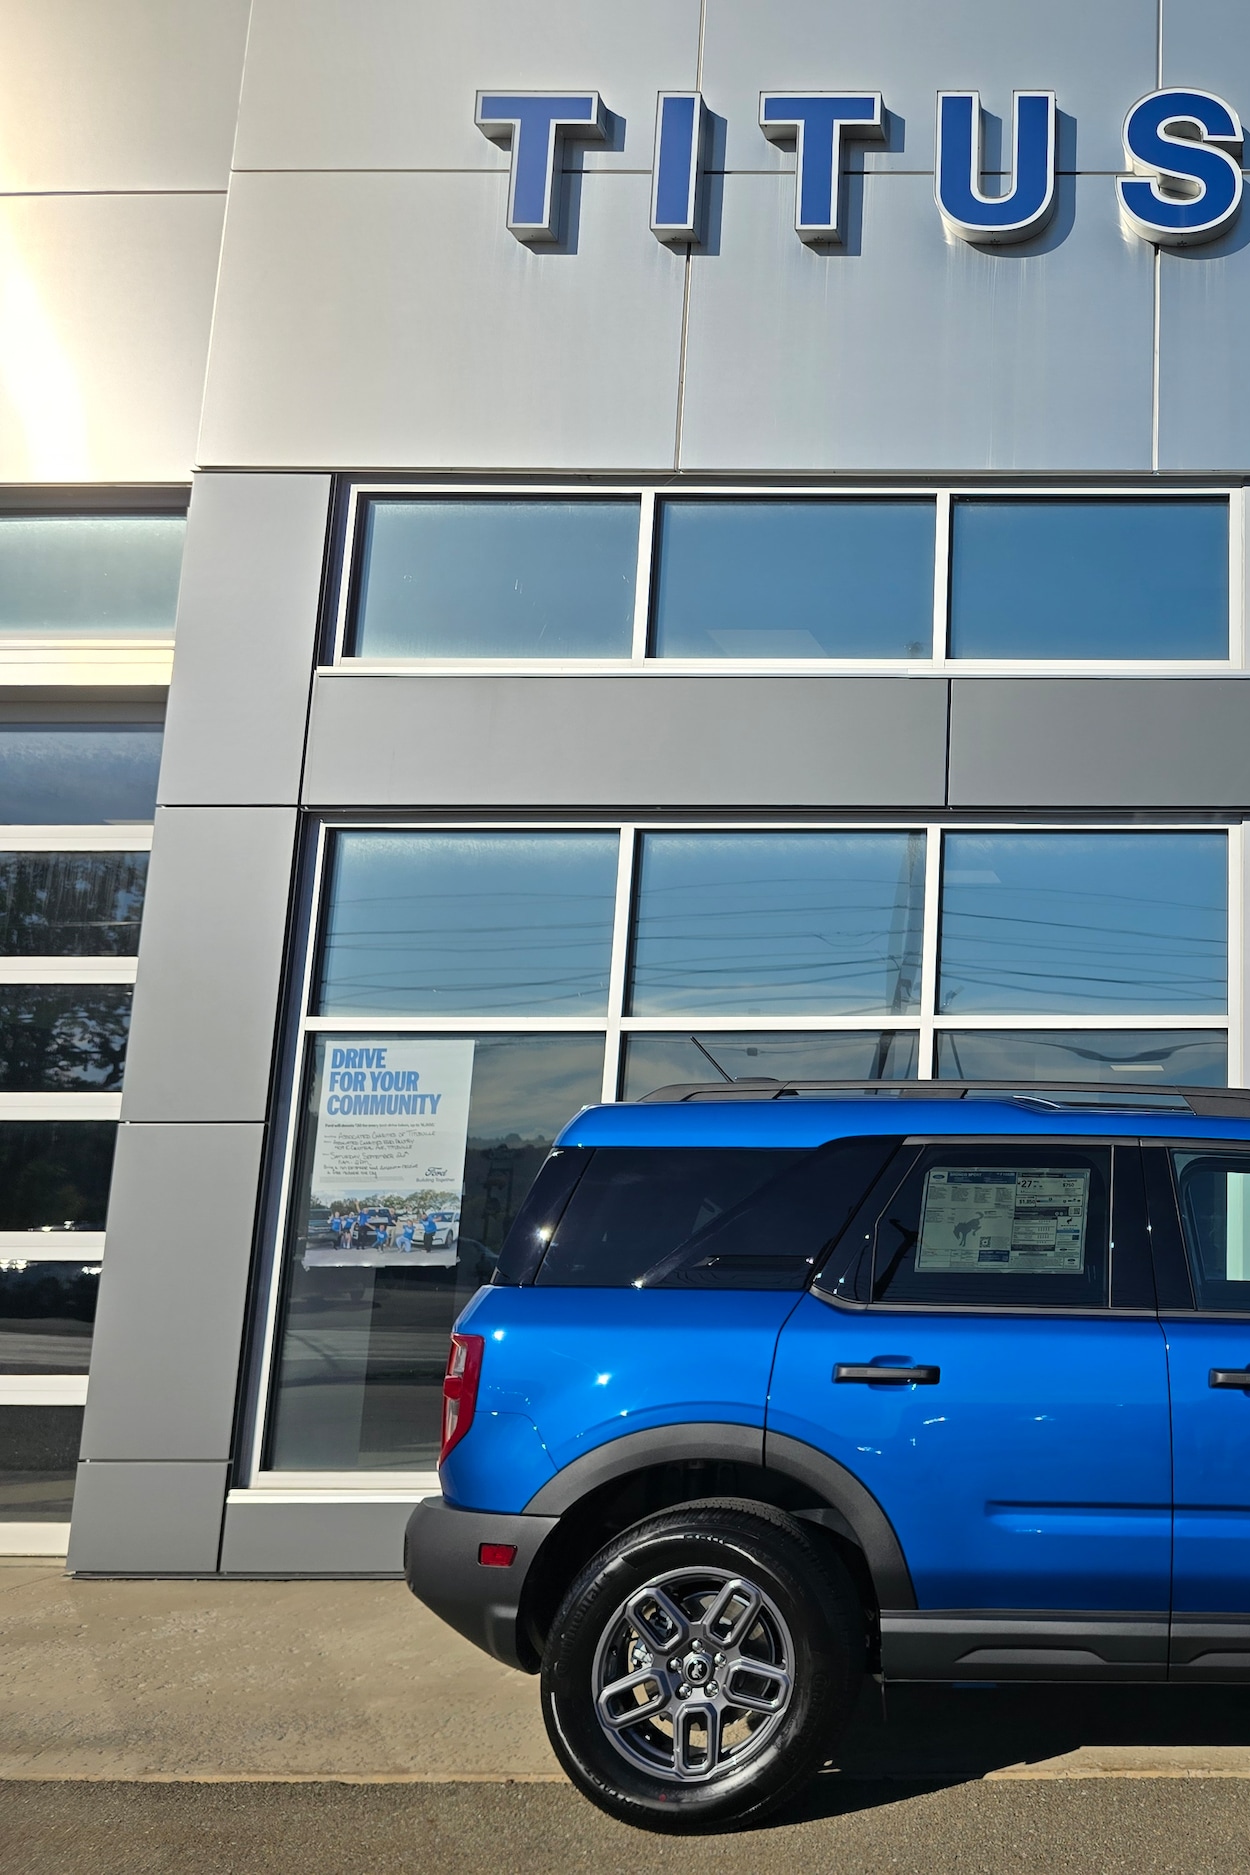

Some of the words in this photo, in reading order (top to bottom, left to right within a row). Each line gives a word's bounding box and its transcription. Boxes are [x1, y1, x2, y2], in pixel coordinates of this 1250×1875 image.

[331, 1048, 387, 1069] DRIVE
[328, 1071, 366, 1092] FOR
[370, 1071, 420, 1092] YOUR
[326, 1093, 442, 1115] COMMUNITY
[424, 1166, 448, 1177] Ford
[1021, 1180, 1032, 1188] 27
